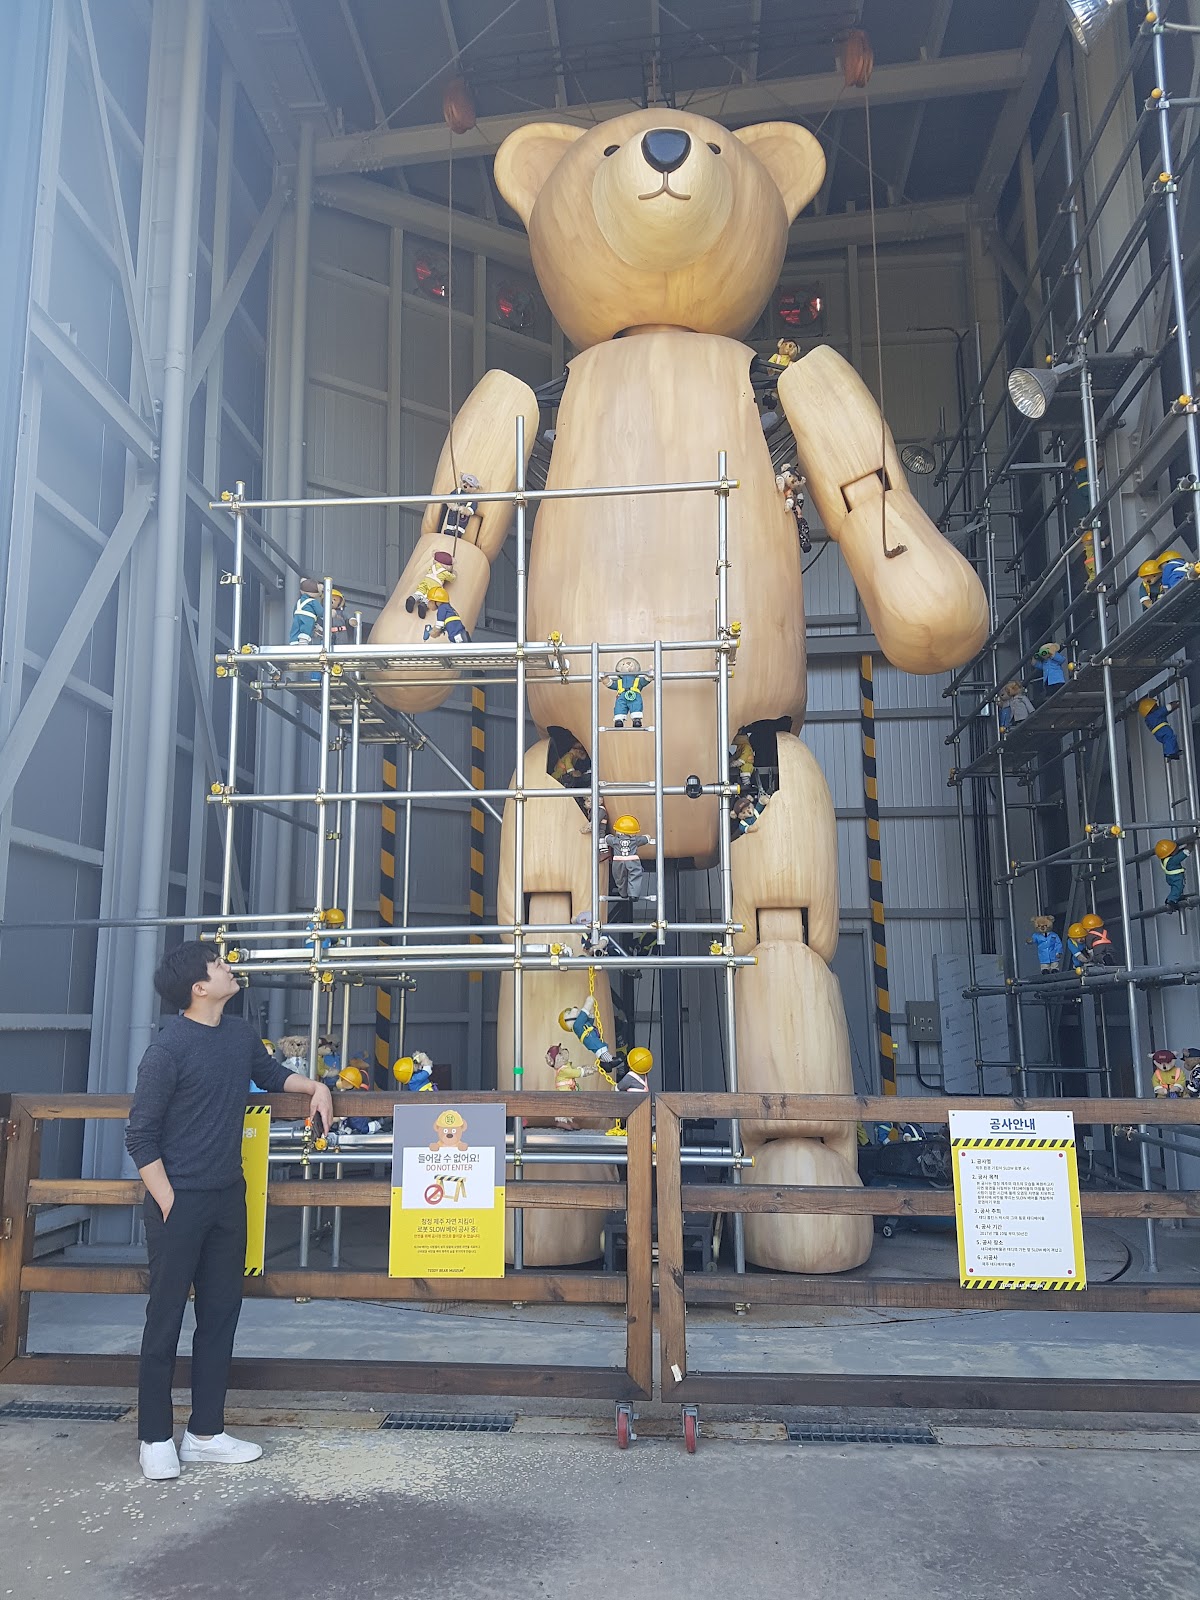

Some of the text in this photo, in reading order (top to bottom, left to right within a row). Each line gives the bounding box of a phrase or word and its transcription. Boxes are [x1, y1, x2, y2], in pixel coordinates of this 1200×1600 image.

[989, 1118, 1036, 1130] 공사안내
[418, 1153, 480, 1164] 들어갈 수 없어요!
